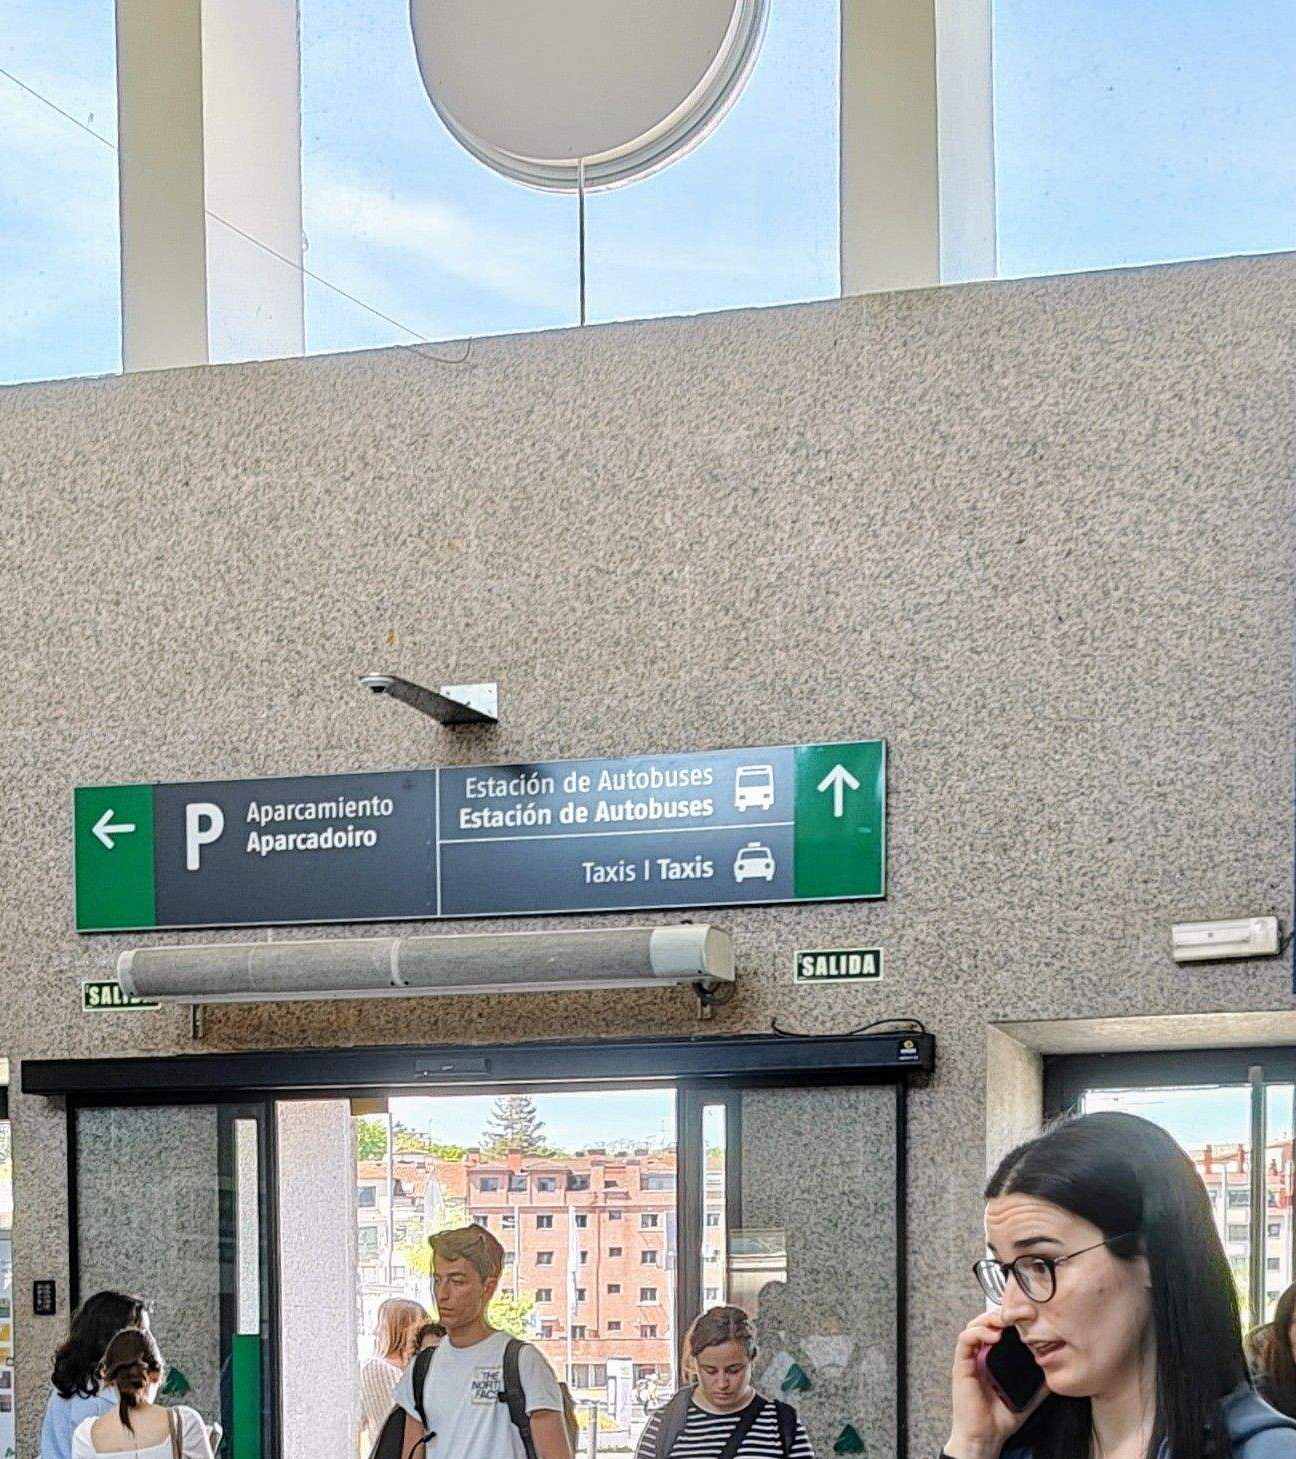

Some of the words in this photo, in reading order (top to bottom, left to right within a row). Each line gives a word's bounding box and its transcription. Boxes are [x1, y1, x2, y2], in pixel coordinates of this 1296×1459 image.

[465, 772, 554, 799] Estación
[563, 770, 591, 794] de
[597, 766, 714, 792] Autobuses
[246, 796, 394, 827] Aparcamiento
[459, 802, 552, 830] Estación
[559, 802, 589, 825] de
[594, 797, 715, 823] Autobuses
[185, 802, 225, 871] P
[246, 825, 378, 857] Aparcadoiro
[582, 860, 637, 884] Taxis
[657, 855, 715, 881] Taxis
[802, 953, 876, 977] SALIDA
[474, 1389, 497, 1400] FAC
